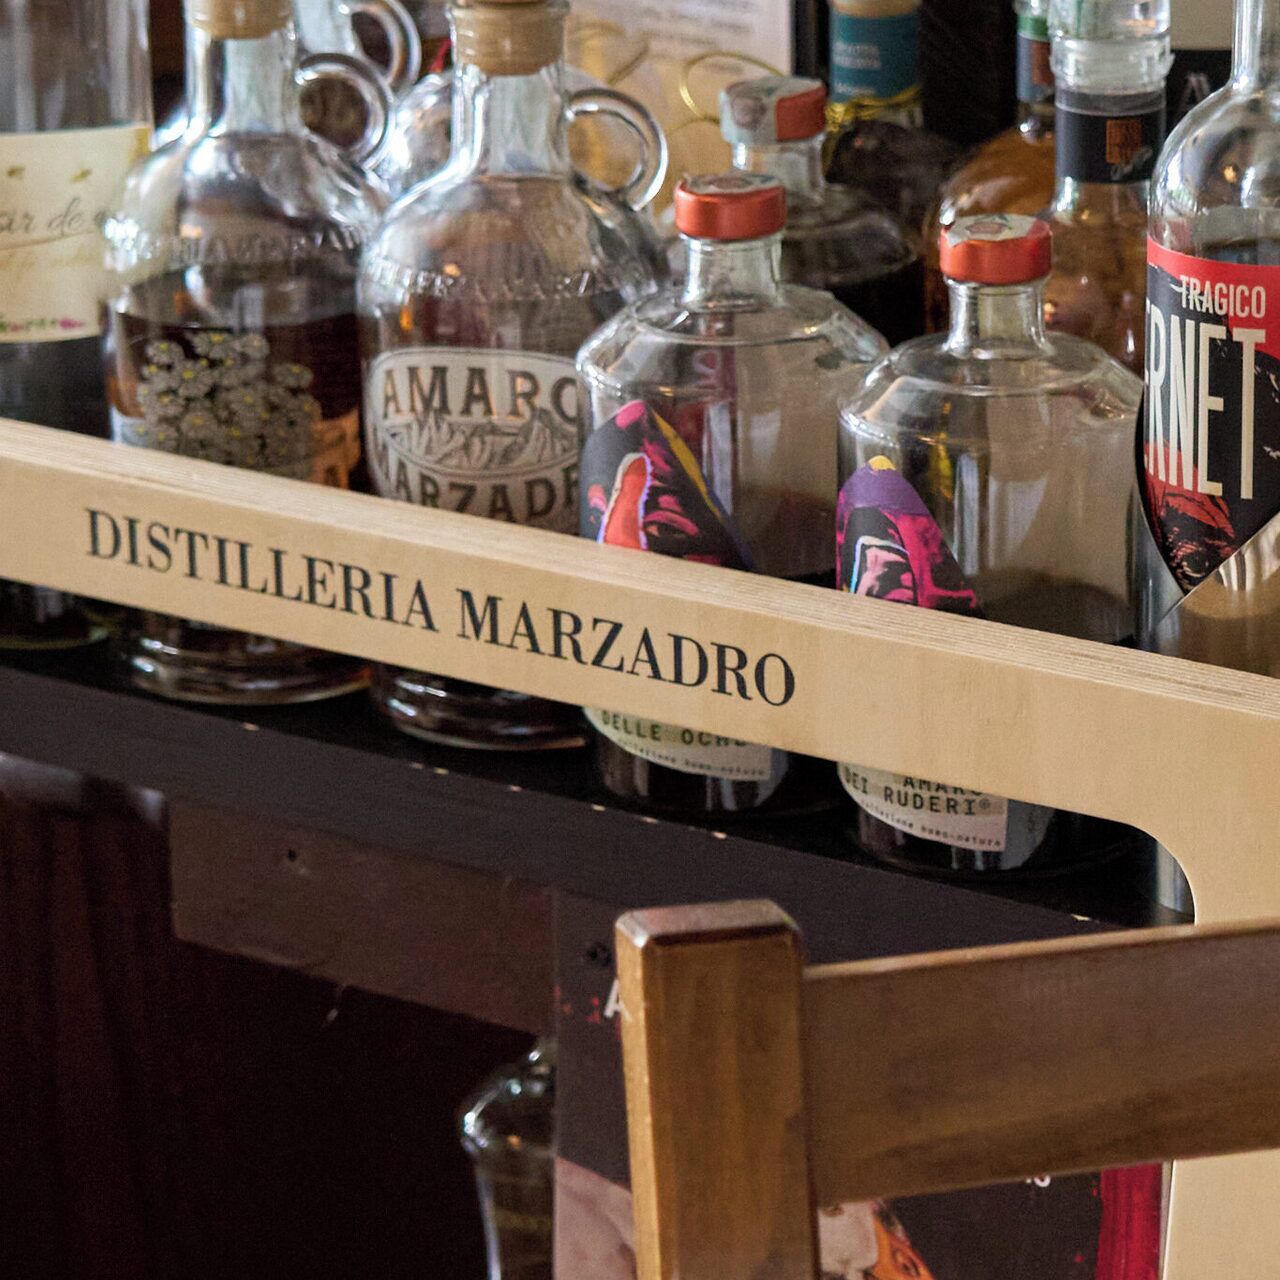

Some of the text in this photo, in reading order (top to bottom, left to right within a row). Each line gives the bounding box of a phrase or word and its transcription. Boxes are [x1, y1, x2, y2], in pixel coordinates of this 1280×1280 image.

[1179, 274, 1266, 319] TRAGICO
[1145, 298, 1266, 500] RNET
[85, 507, 796, 707] DISTILLERIA MARZADRO
[602, 710, 661, 741] DELLE
[902, 776, 984, 796] AMA
